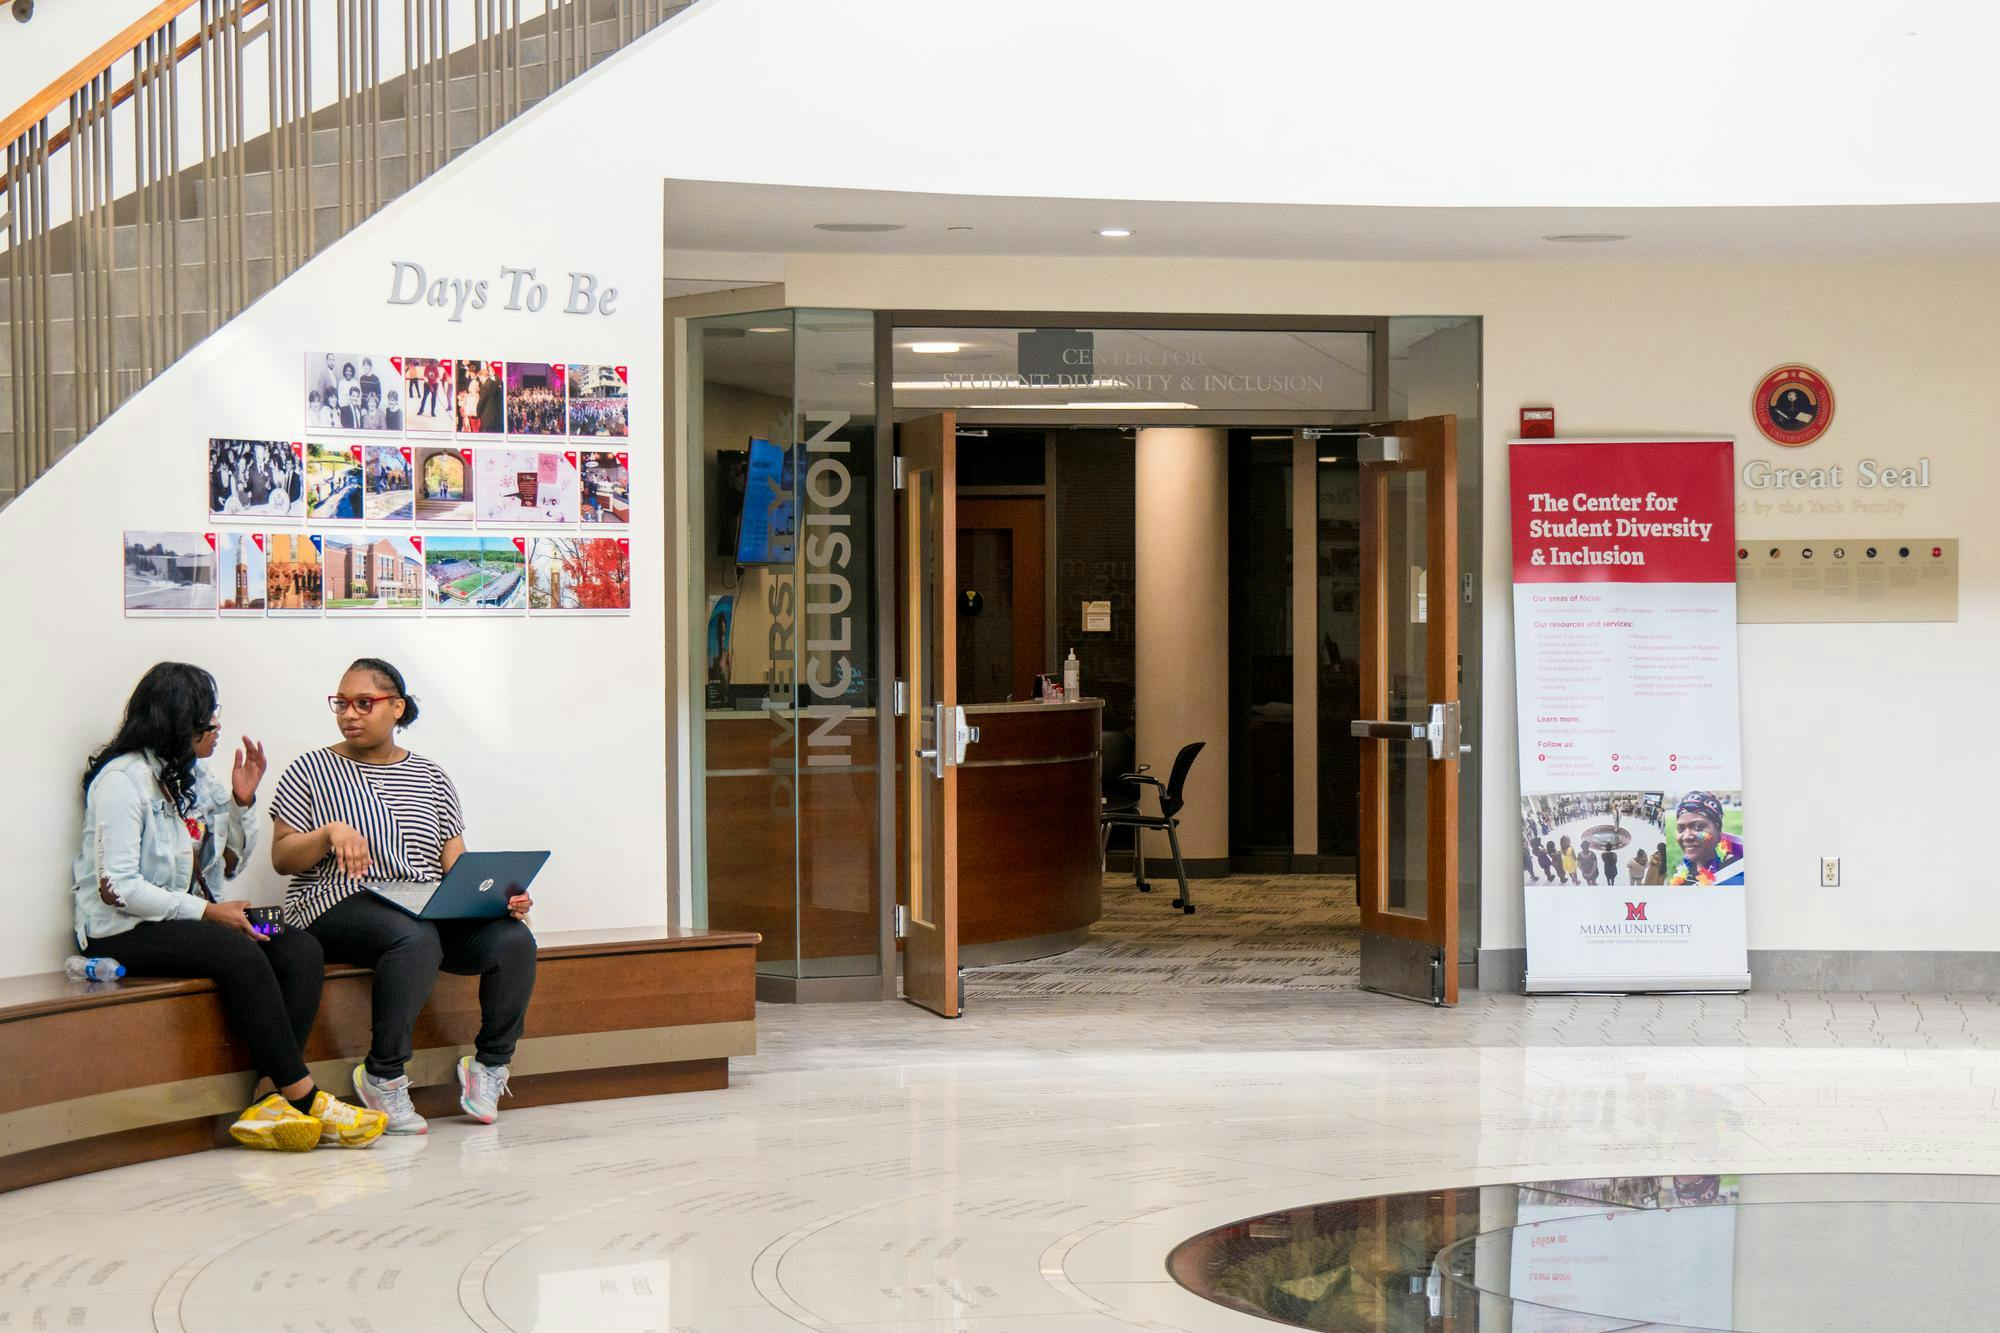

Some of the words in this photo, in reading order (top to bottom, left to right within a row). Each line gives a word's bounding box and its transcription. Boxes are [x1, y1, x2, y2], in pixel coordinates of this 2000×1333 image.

[386, 261, 489, 322] Days
[500, 265, 548, 313] To
[562, 272, 619, 316] Be
[1062, 348, 1155, 366] CENTER
[1159, 348, 1209, 366] FOR
[942, 373, 1050, 392] STUDENT
[1057, 373, 1176, 392] DIVERSITY
[1180, 374, 1196, 391] &
[1204, 375, 1323, 392] INCLUSION
[1742, 459, 1844, 490] Great
[1857, 457, 1931, 489] Seal
[1529, 493, 1569, 512] The
[1572, 493, 1642, 512] Center
[1645, 492, 1678, 512] for
[1753, 500, 1773, 517] by
[1779, 499, 1804, 515] the
[1529, 518, 1613, 538] Student
[1616, 517, 1712, 542] Diversity
[1531, 548, 1546, 566] &
[1550, 545, 1645, 566] Inclusion
[806, 410, 852, 767] INCLUSION
[1570, 594, 1578, 602] of
[1533, 620, 1547, 628] Our
[1587, 620, 1601, 628] and
[1602, 619, 1634, 628] services:
[1537, 715, 1558, 723] Learn
[1537, 740, 1562, 748] Follow
[1624, 902, 1648, 920] M
[1580, 924, 1621, 935] MIAMI
[1624, 923, 1693, 935] UNIVERSITY
